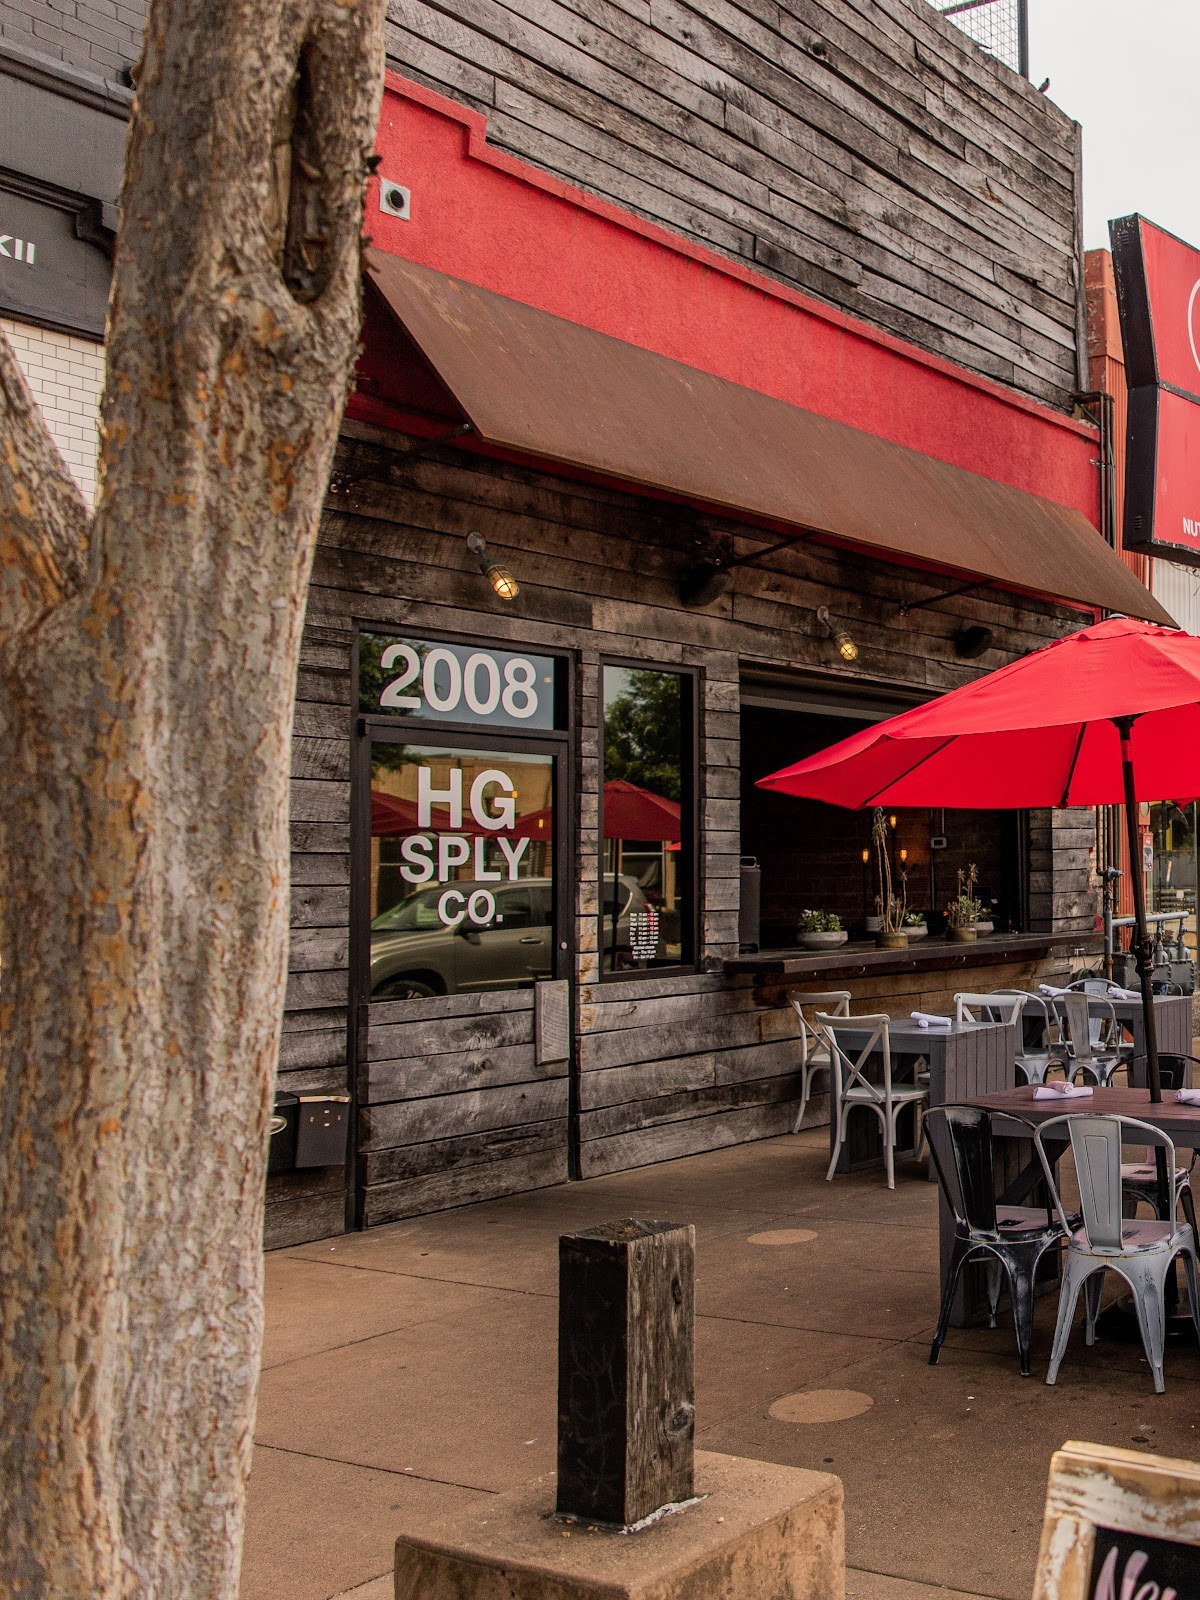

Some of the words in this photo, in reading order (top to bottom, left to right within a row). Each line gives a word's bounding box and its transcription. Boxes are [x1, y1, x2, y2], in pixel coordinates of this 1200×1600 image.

[380, 643, 538, 719] 2008
[417, 767, 515, 830] HG
[400, 836, 530, 883] SPLY
[438, 889, 503, 925] CO.
